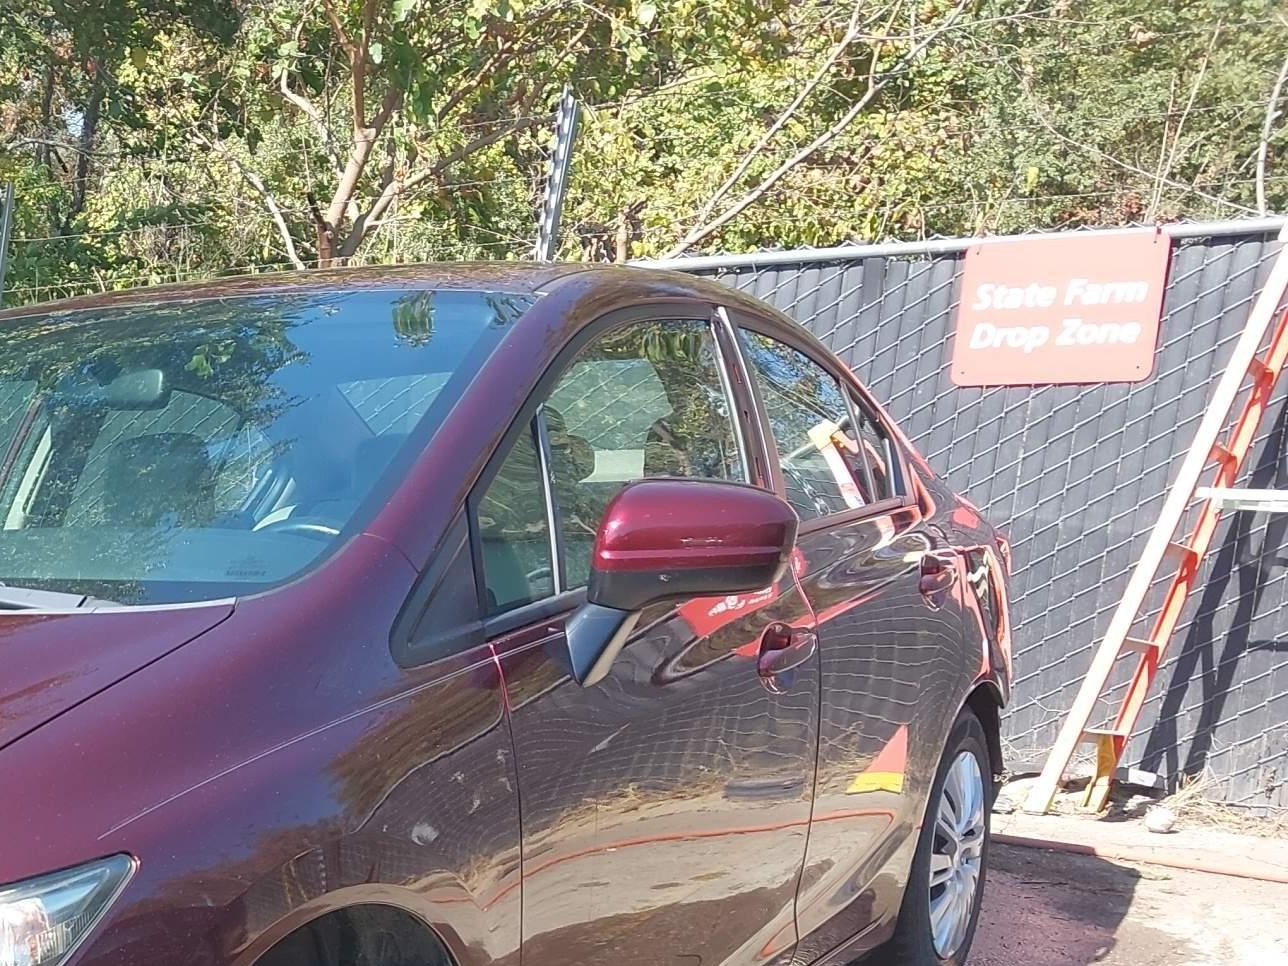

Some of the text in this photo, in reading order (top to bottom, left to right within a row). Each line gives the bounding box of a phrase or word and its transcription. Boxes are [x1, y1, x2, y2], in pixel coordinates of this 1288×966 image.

[972, 278, 1149, 311] State Farm
[969, 318, 1141, 353] Drop Zone
